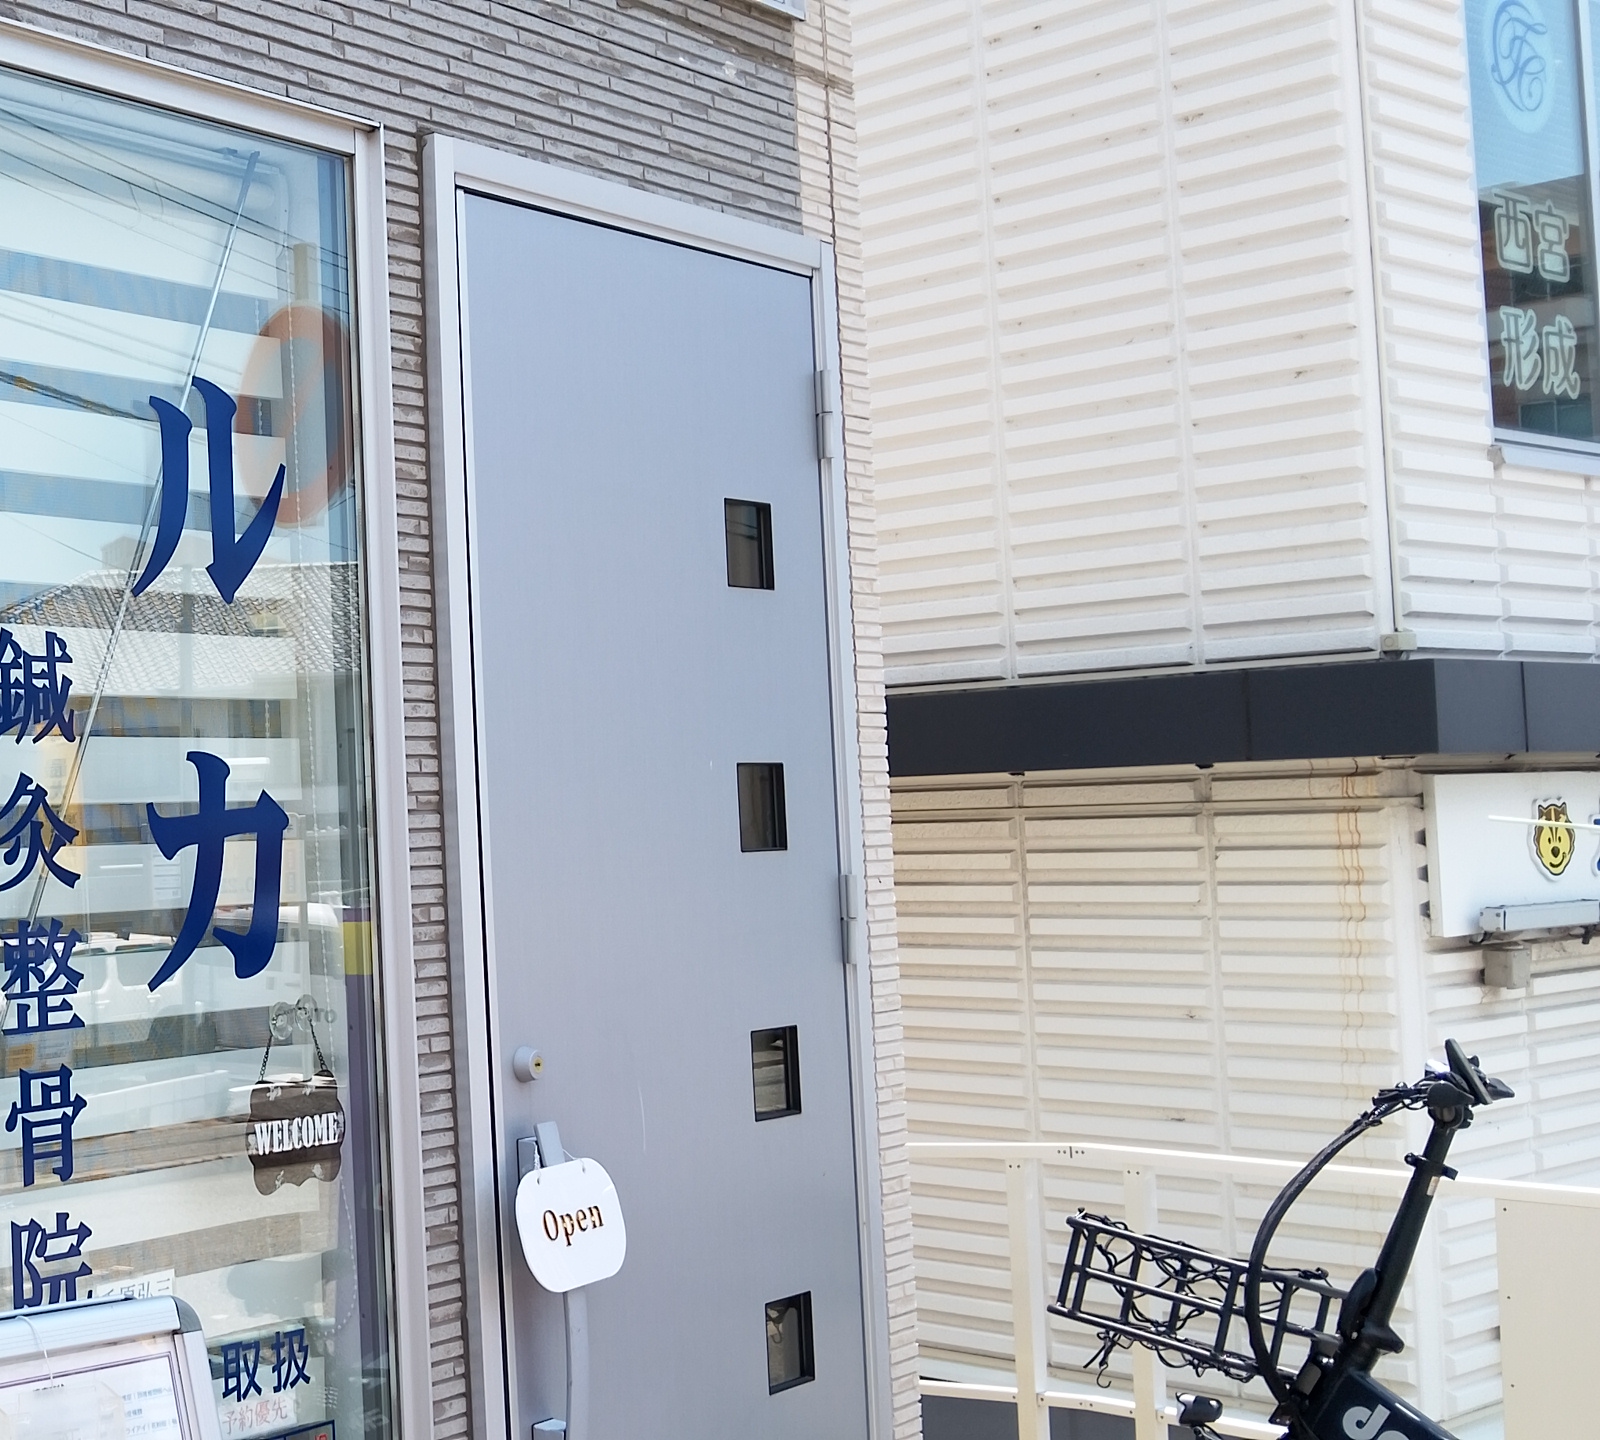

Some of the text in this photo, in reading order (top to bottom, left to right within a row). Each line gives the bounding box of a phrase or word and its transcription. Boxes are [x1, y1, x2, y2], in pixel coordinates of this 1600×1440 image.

[1492, 188, 1571, 283] 西宮
[1499, 304, 1581, 400] 形成
[132, 375, 290, 992] ルカ
[254, 1112, 339, 1157] WELCOME
[542, 1204, 605, 1247] Open
[209, 1328, 311, 1403] 取扱
[221, 1395, 289, 1436] 予約優先
